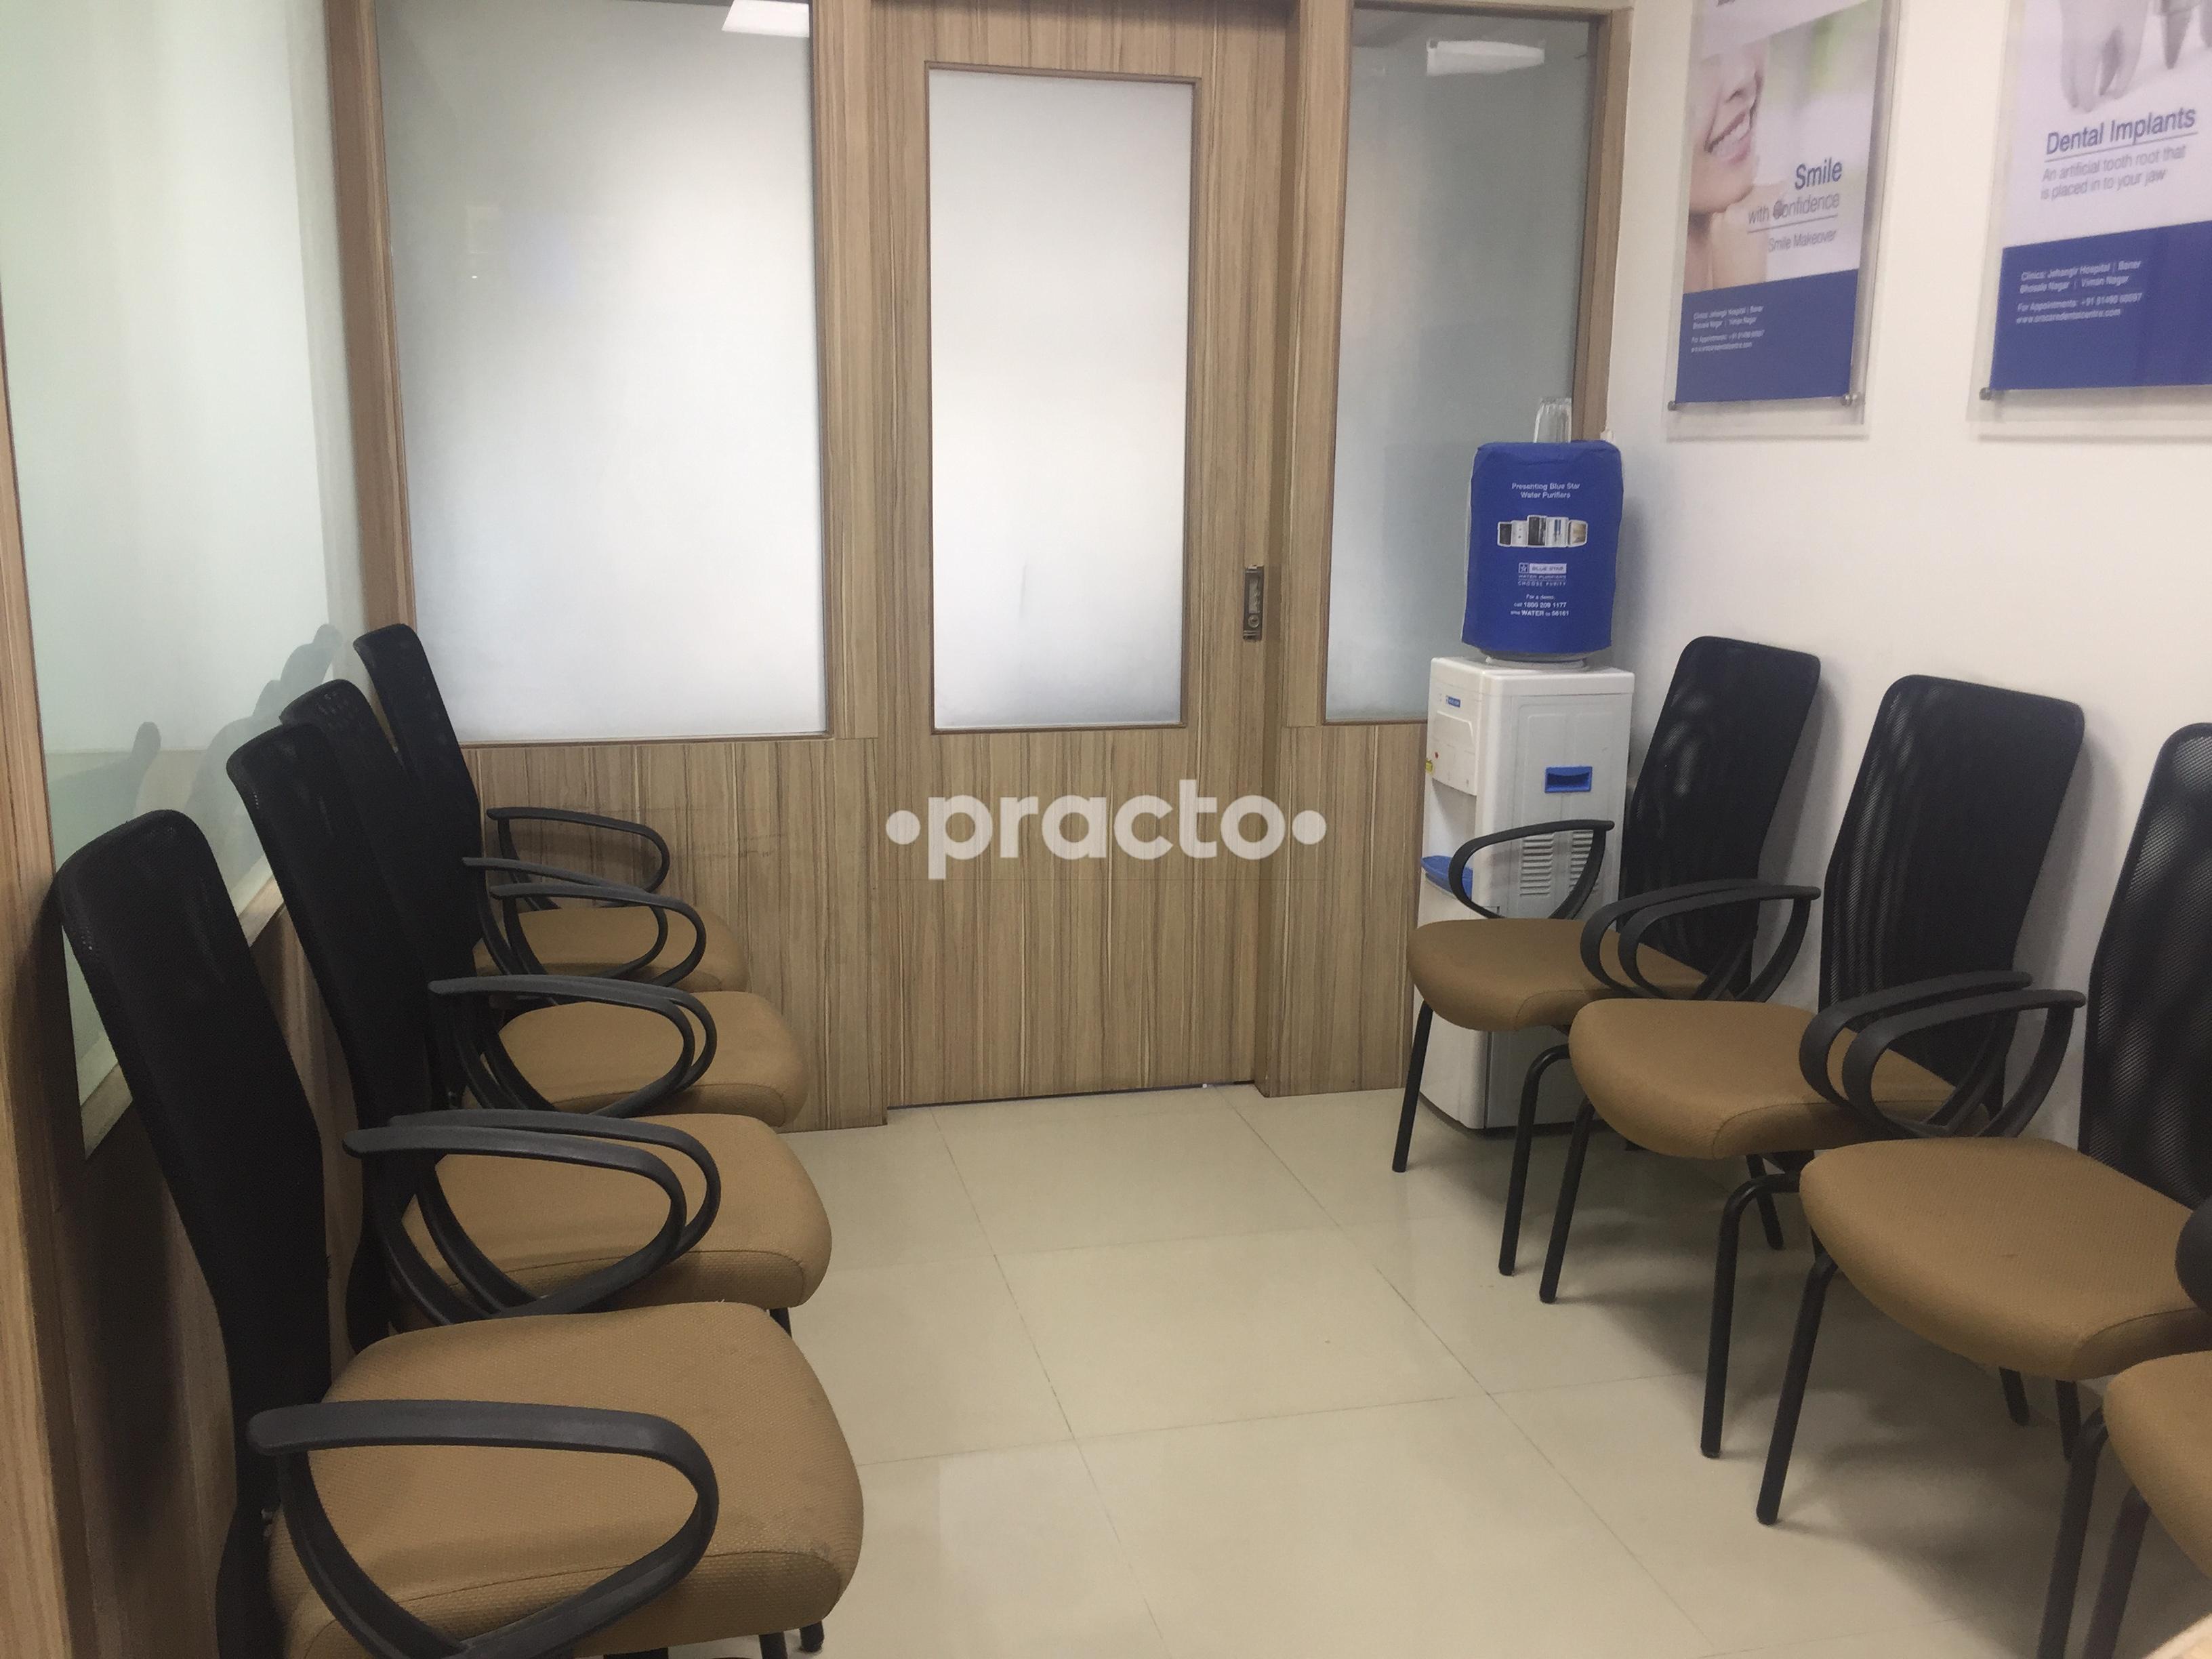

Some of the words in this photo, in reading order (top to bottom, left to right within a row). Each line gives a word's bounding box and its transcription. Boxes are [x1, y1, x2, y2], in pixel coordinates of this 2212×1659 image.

[2047, 122, 2104, 155] Dental
[2110, 106, 2196, 146] Implants
[1795, 157, 1843, 190] Smile
[2042, 168, 2057, 182] An
[2059, 159, 2100, 180] artificial
[2104, 154, 2133, 171] tooth
[2135, 150, 2160, 166] root
[2163, 145, 2186, 162] that
[2041, 188, 2050, 201] is
[2051, 180, 2087, 201] placed
[2091, 178, 2101, 192] in
[2104, 177, 2115, 190] to
[2117, 172, 2142, 191] your
[2145, 169, 2166, 186] jaw
[1748, 205, 1770, 224] with
[1773, 192, 1840, 219] Confidence
[1768, 237, 1791, 253] Smile
[1794, 229, 1837, 249] Makeover
[1512, 483, 1547, 491] Presenting
